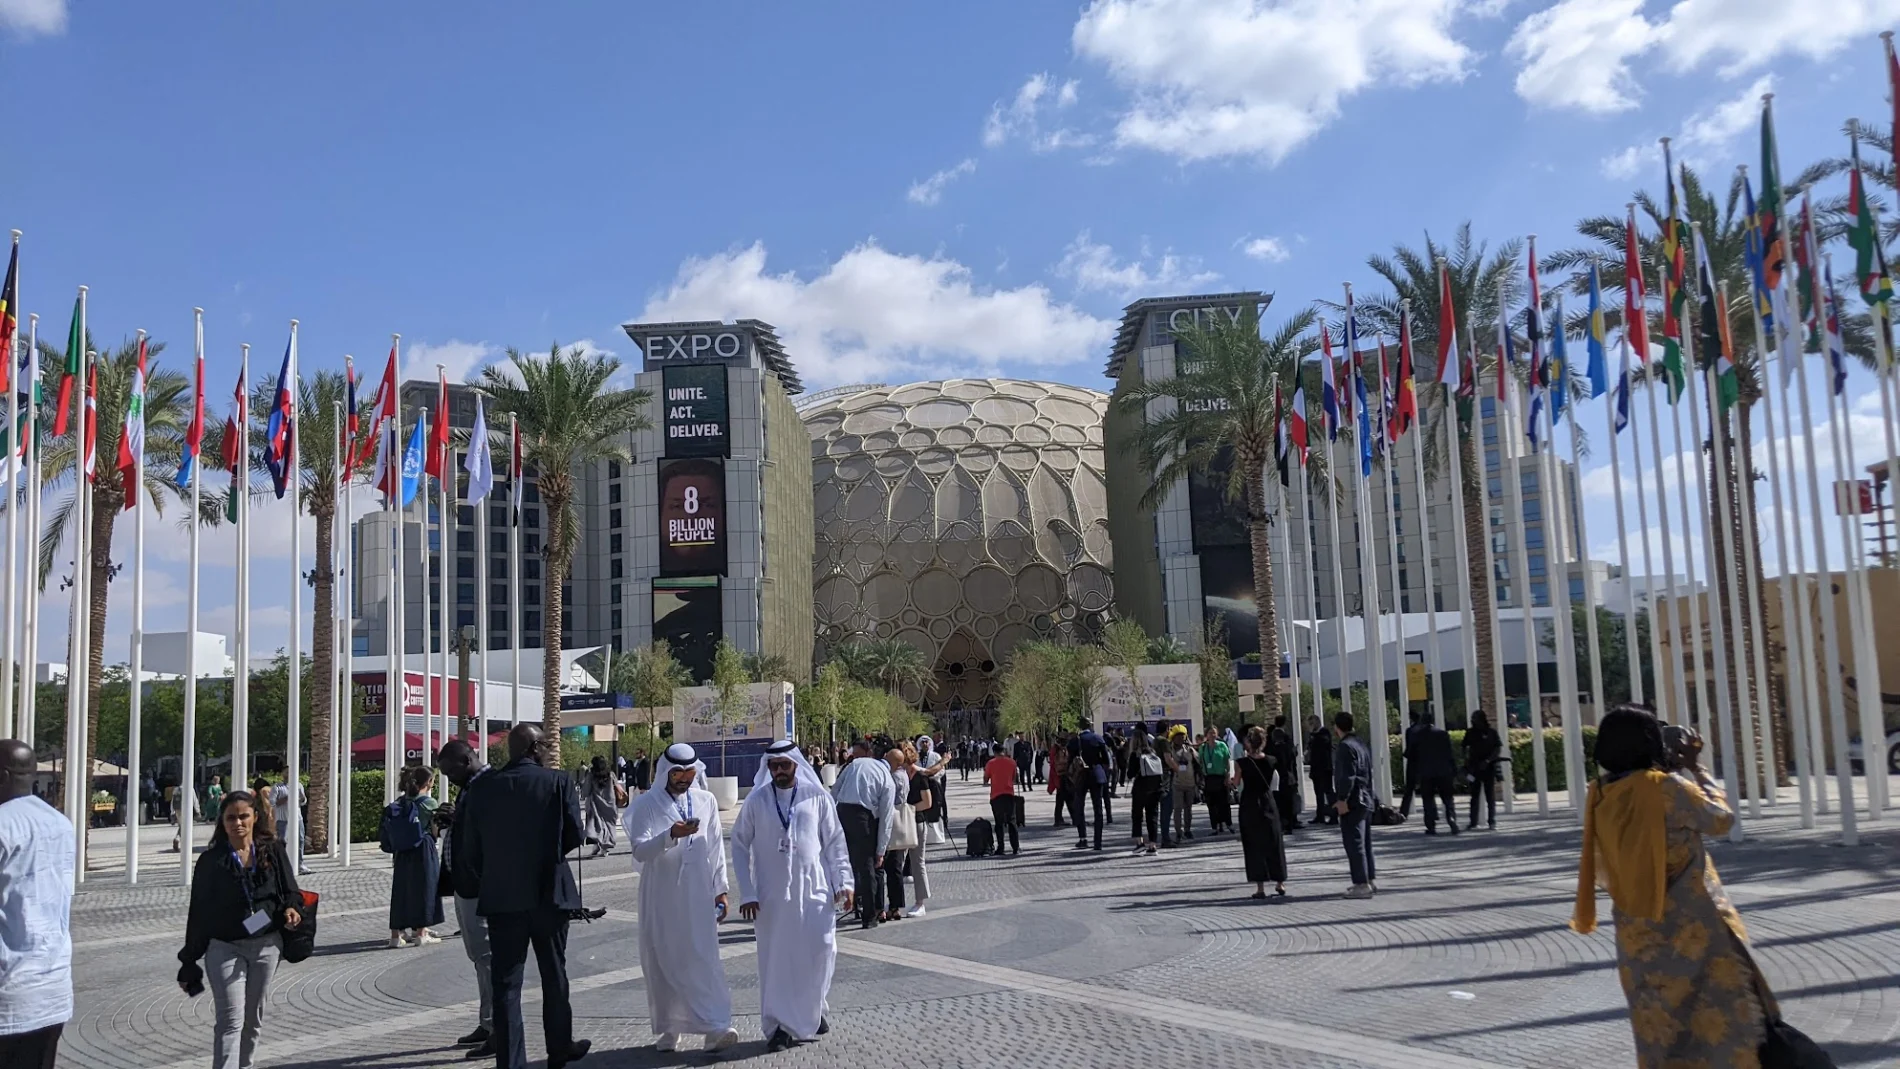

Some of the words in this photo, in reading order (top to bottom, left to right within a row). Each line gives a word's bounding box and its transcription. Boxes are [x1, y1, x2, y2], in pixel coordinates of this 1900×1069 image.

[1170, 306, 1243, 332] CITY
[646, 333, 740, 359] EXPO
[669, 387, 707, 400] UNITE.
[669, 406, 696, 419] ACT.
[669, 424, 723, 438] DELIVER.
[684, 486, 699, 514] 8
[669, 518, 715, 532] BILLION
